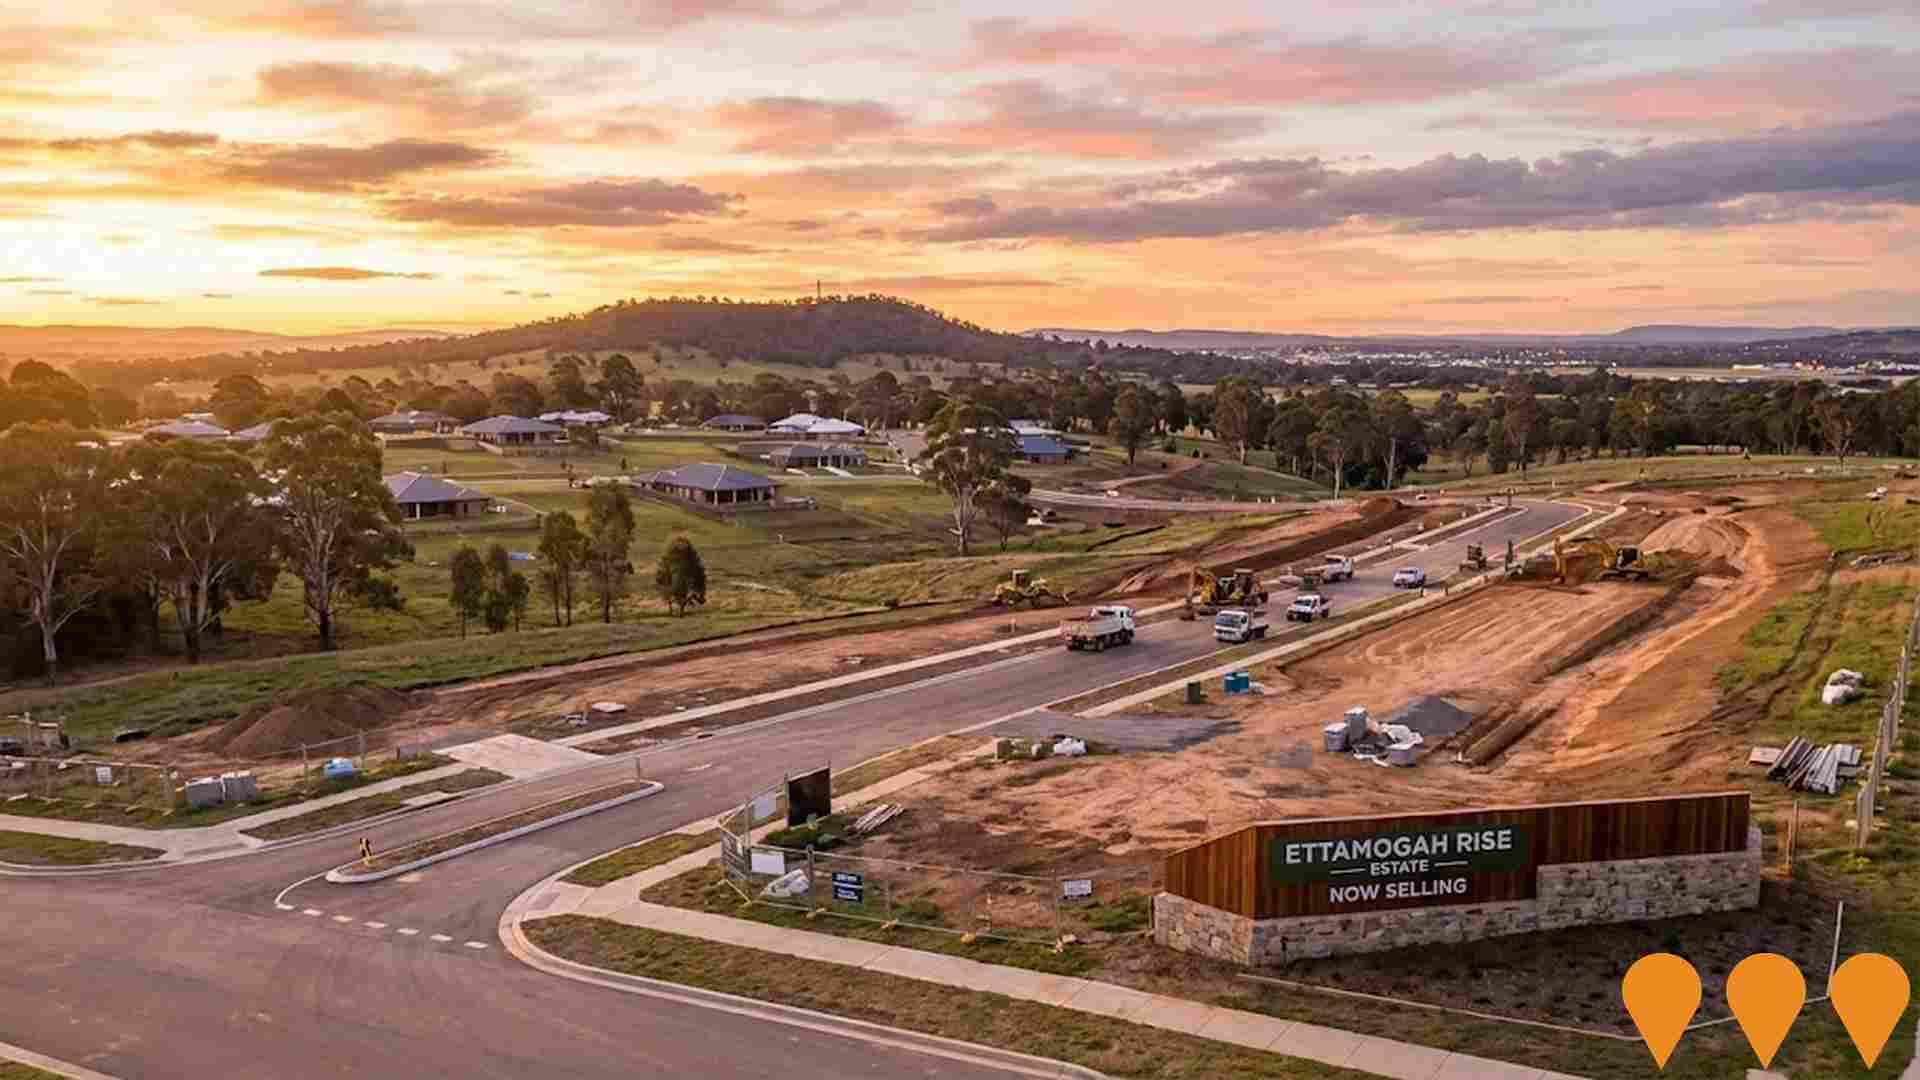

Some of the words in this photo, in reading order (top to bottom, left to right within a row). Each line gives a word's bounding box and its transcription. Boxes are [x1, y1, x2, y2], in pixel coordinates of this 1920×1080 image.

[1285, 833, 1449, 864] ETTAMOGAH
[1456, 829, 1512, 853] RISE
[1370, 859, 1429, 876] ESTATE
[1329, 884, 1381, 903] NOW
[1385, 878, 1468, 899] SELLING
